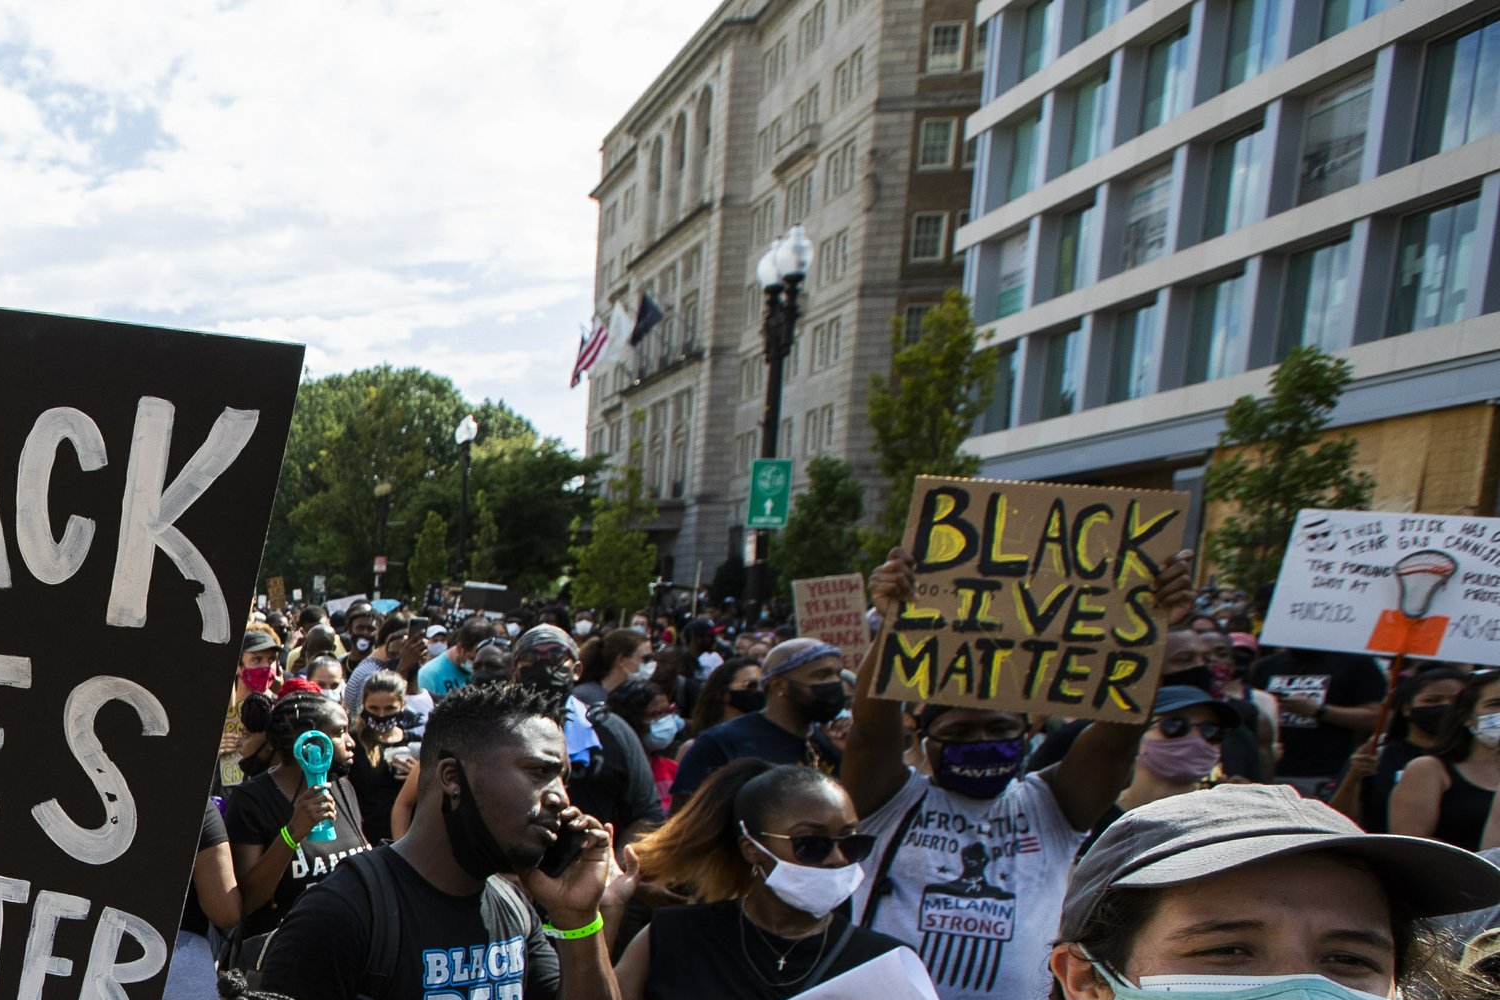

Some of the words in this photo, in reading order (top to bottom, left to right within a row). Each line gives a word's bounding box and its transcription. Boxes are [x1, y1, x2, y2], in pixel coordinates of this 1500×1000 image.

[913, 486, 1181, 590] BLACK
[1399, 518, 1446, 534] STICK
[1460, 521, 1488, 538] HAS
[894, 578, 1157, 648] LIVES
[875, 632, 1149, 714] MATTER
[924, 897, 1014, 921] MELANIN
[925, 912, 1006, 936] STRONG
[423, 935, 525, 988] BLACK
